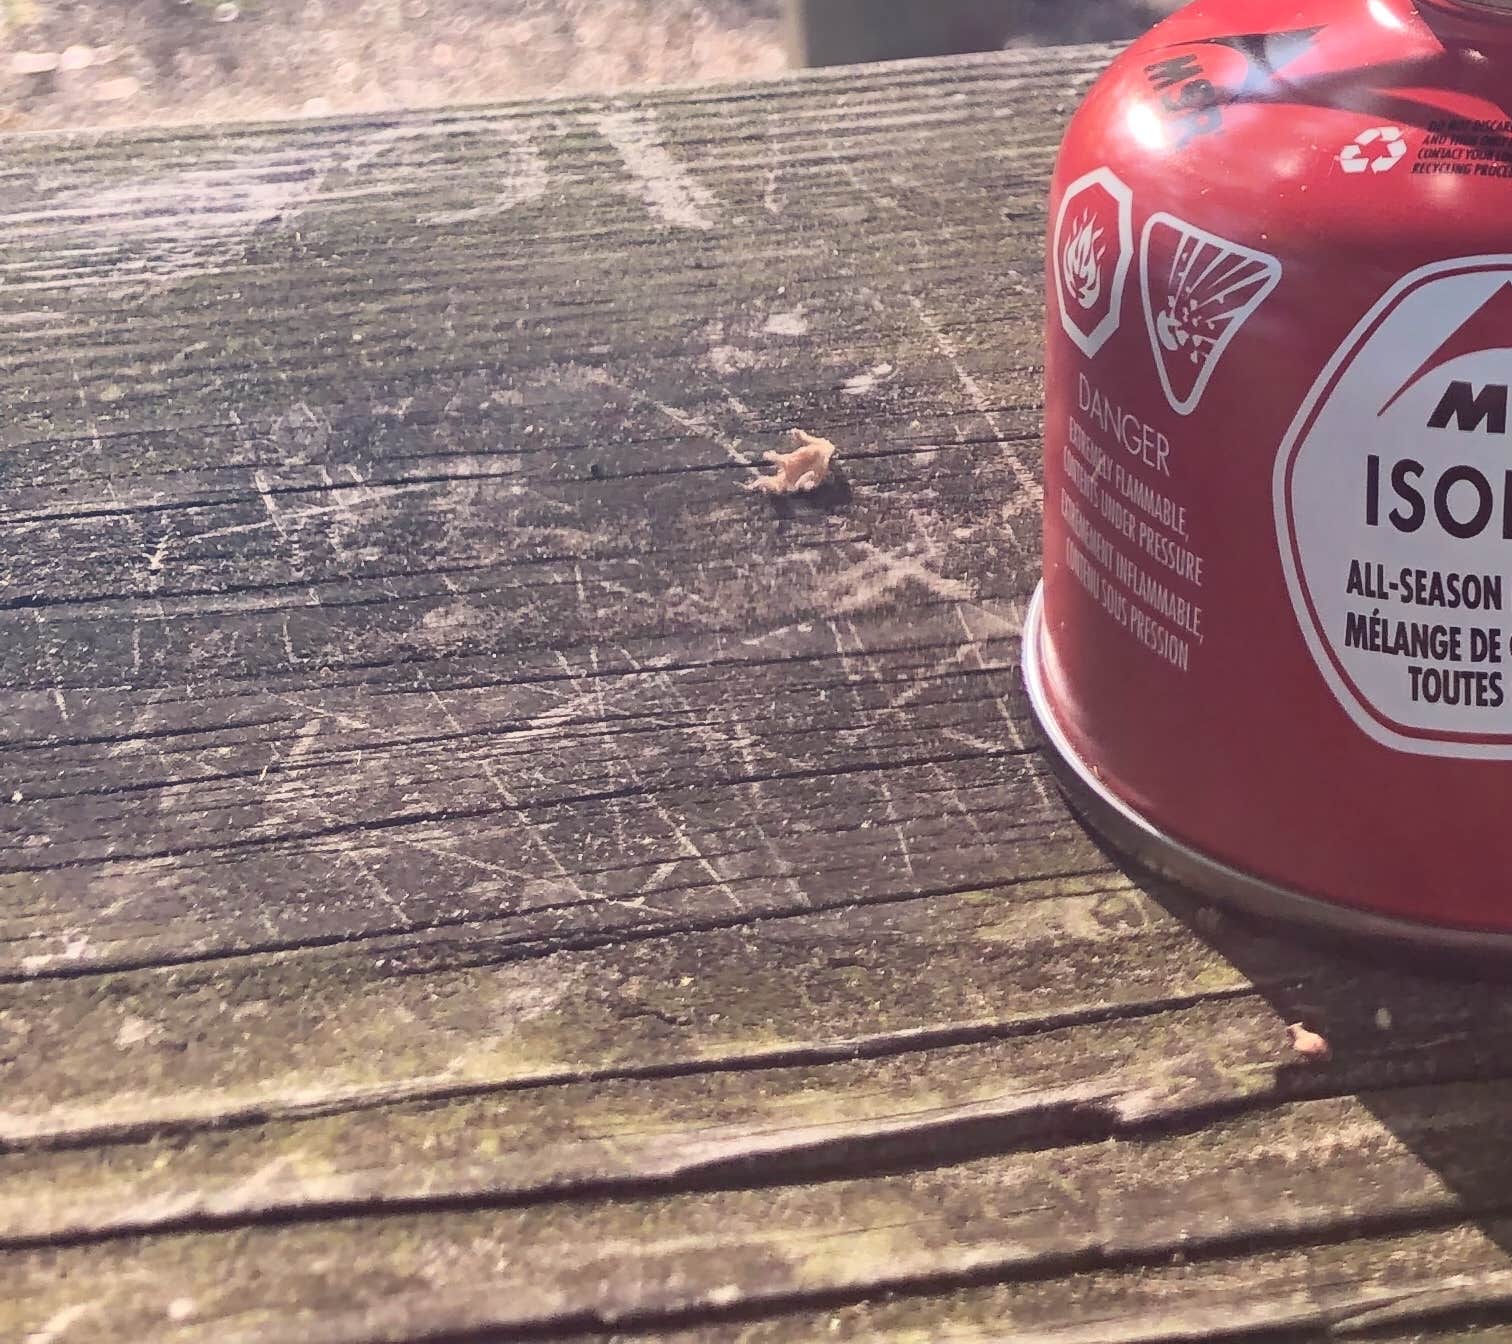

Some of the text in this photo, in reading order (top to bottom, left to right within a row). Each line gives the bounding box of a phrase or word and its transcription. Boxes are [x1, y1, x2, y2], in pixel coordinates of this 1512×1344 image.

[1080, 372, 1170, 477] DANGER
[1069, 416, 1190, 542] EXTREMELY FLAMMABLE,
[1101, 490, 1136, 542] UNDER
[1139, 522, 1204, 587] PRESSURE
[1346, 559, 1502, 610] ALL-SEASON
[1101, 578, 1128, 627] SOUS
[1130, 605, 1190, 672] PRESSION
[1116, 552, 1204, 645] INFLAMMABLE,
[1345, 608, 1461, 661] MÉLANGE
[1470, 627, 1501, 663] DE
[1408, 666, 1503, 707] TOUTES
